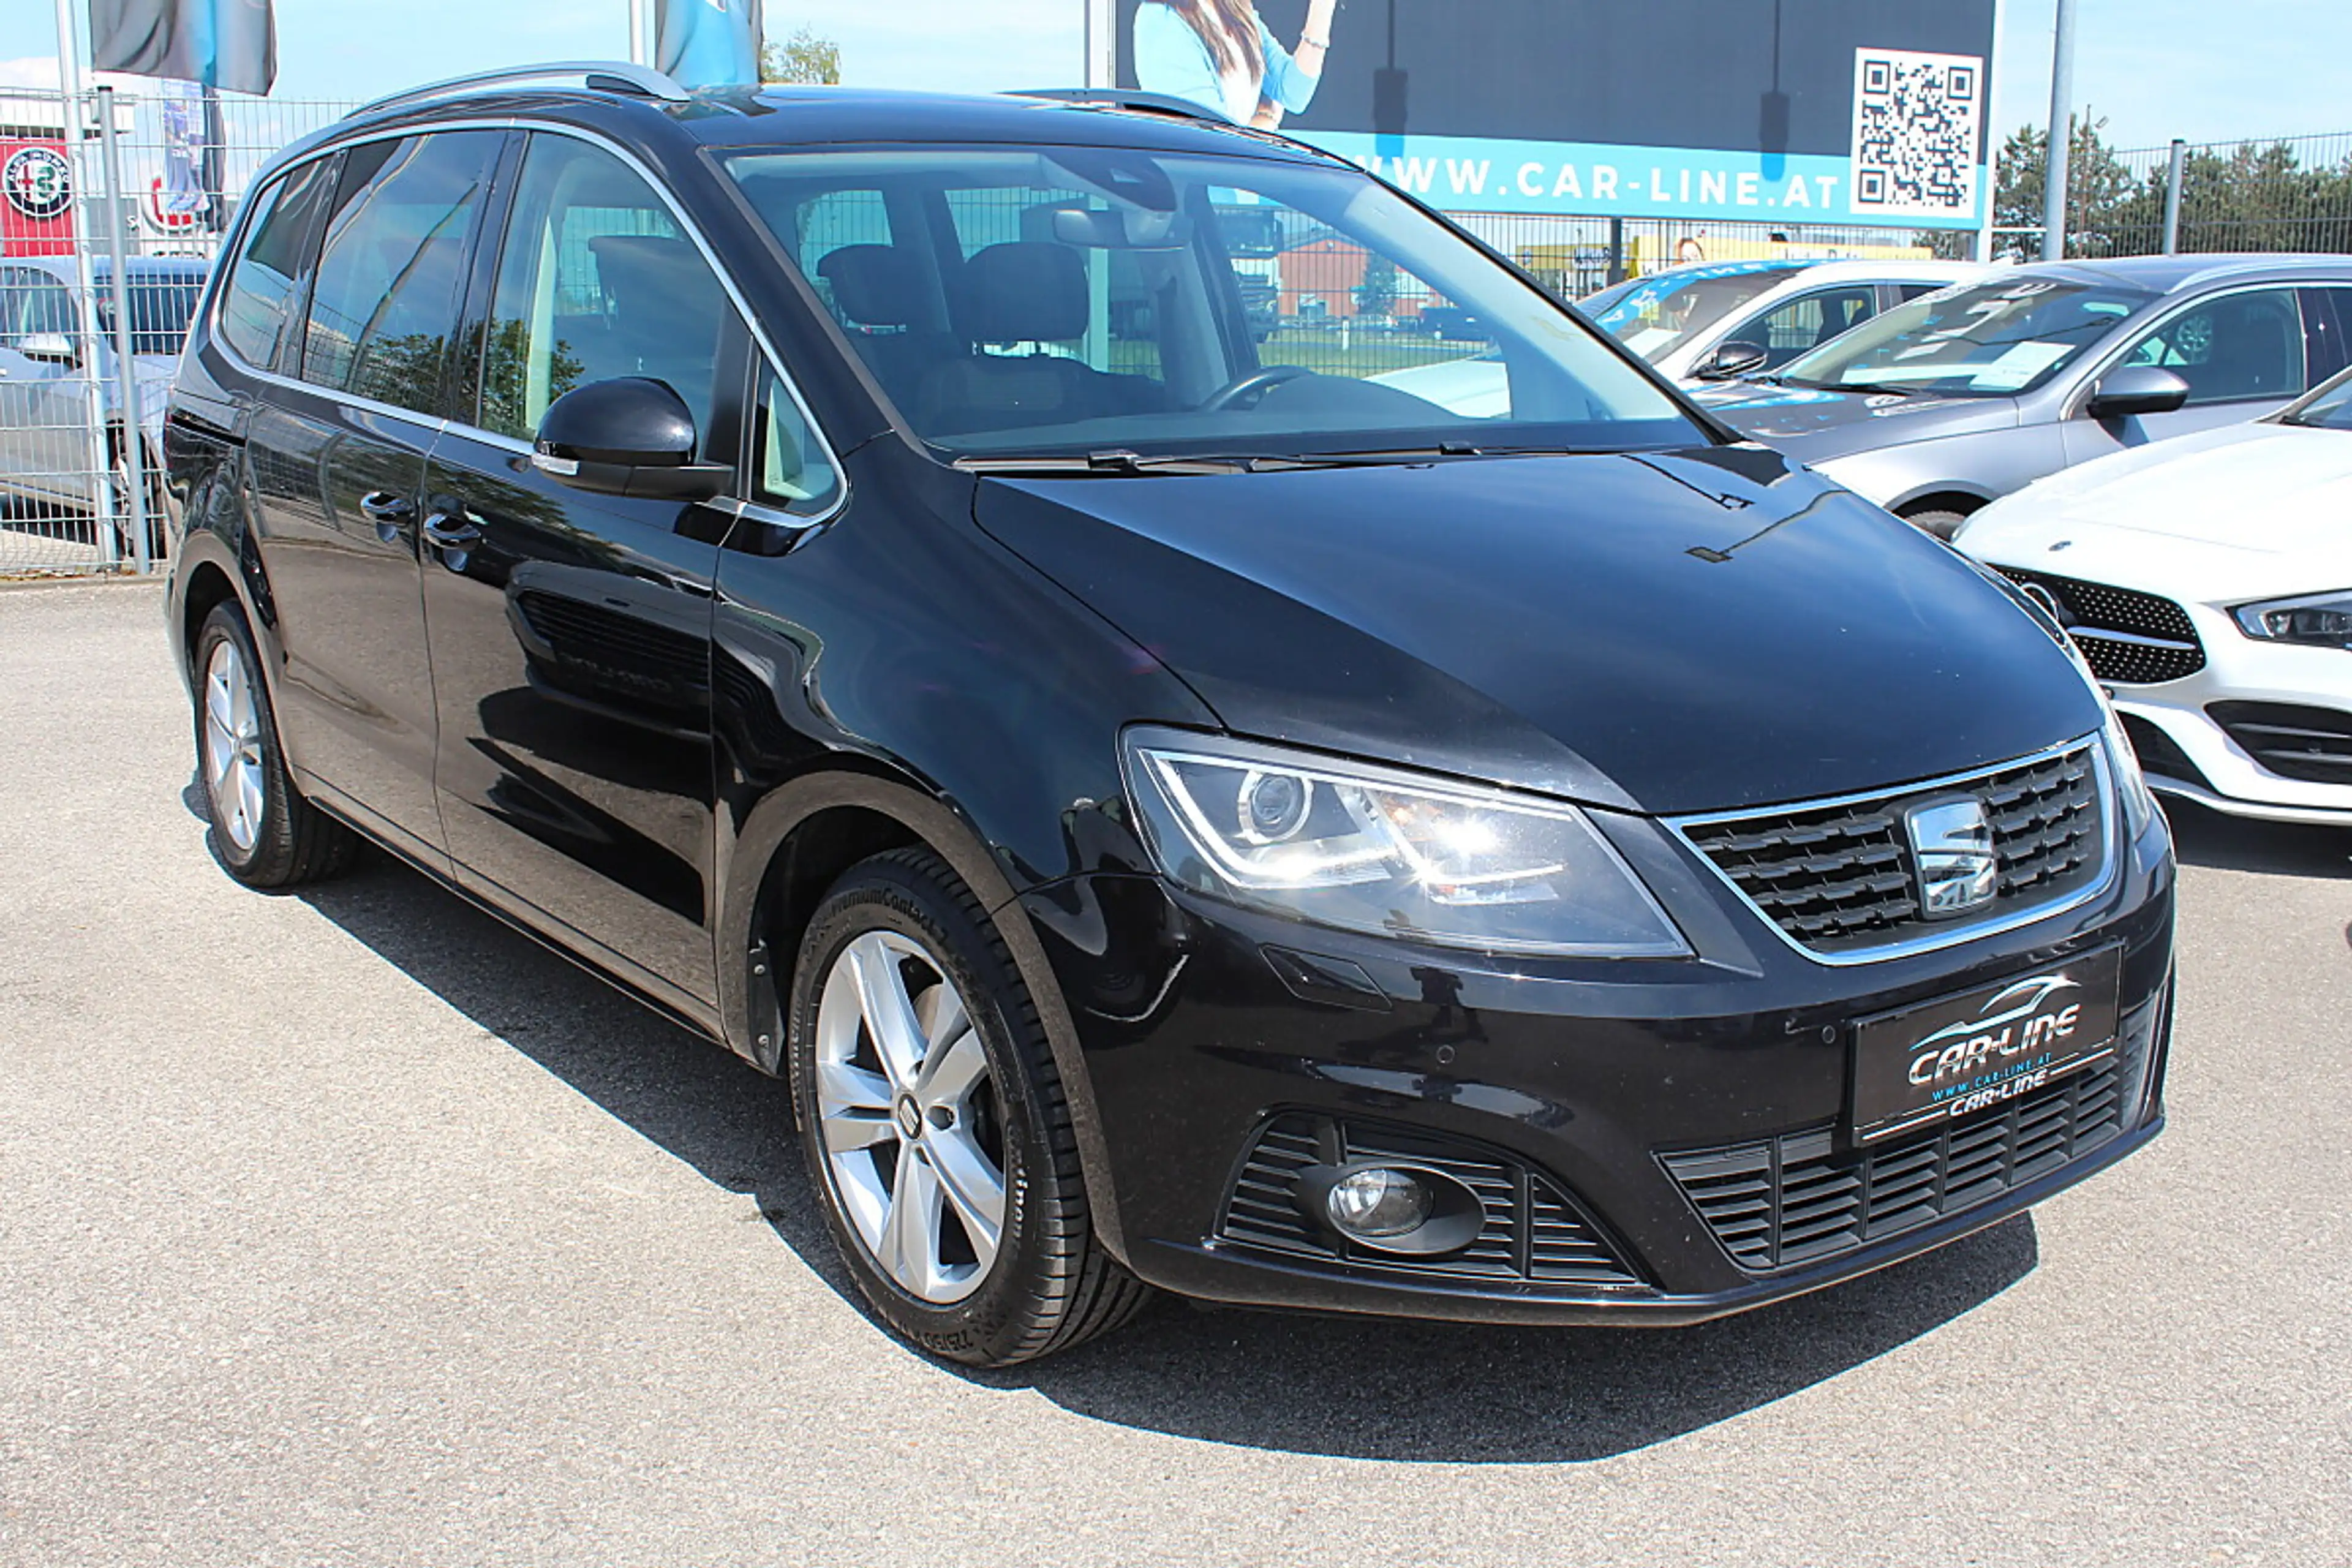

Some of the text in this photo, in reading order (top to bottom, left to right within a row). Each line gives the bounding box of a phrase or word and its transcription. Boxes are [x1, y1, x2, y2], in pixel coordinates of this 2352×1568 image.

[1909, 1003, 2081, 1085] CAR-LINE
[1932, 1052, 2051, 1101] WWW.CAR-LINE.AT
[1950, 1069, 2048, 1116] CAR-LINE
